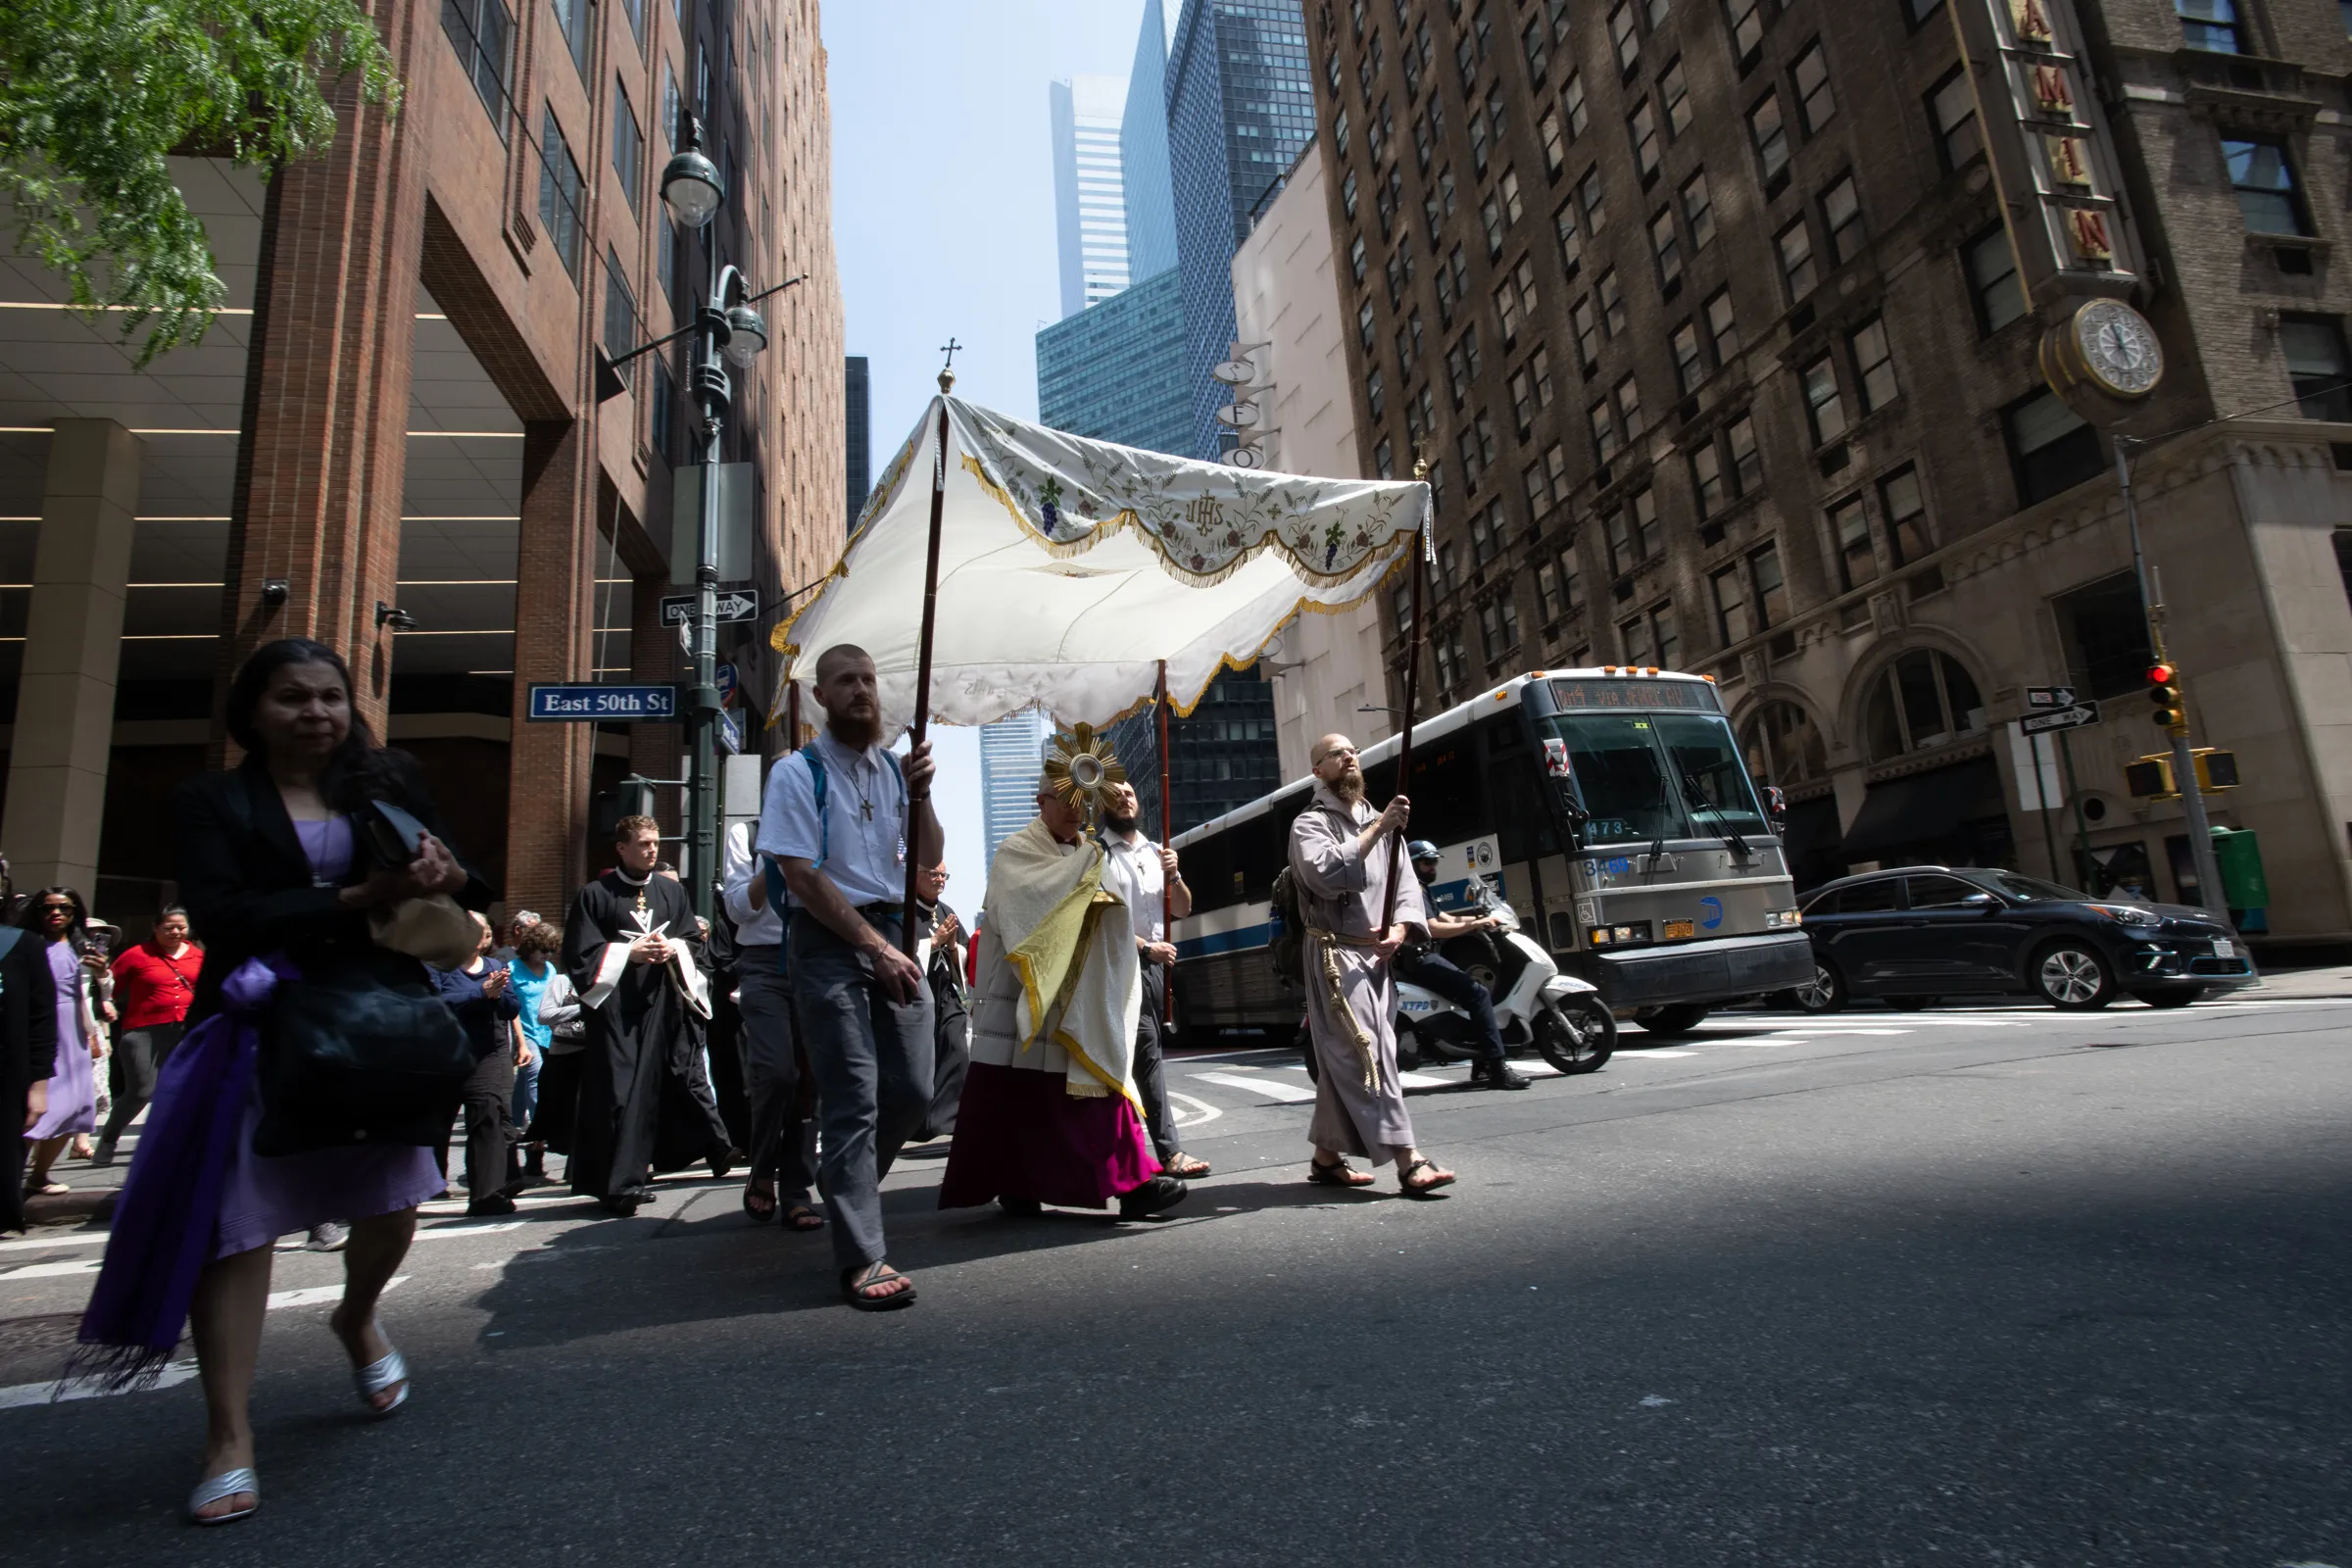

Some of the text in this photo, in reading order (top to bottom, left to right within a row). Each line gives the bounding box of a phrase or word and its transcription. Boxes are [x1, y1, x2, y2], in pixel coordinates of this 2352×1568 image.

[669, 600, 744, 617] ONE WAY
[544, 693, 668, 711] East 50th St
[2031, 710, 2084, 728] ONE WAY
[1584, 856, 1629, 877] 3469
[1400, 1000, 1431, 1011] NYPD
